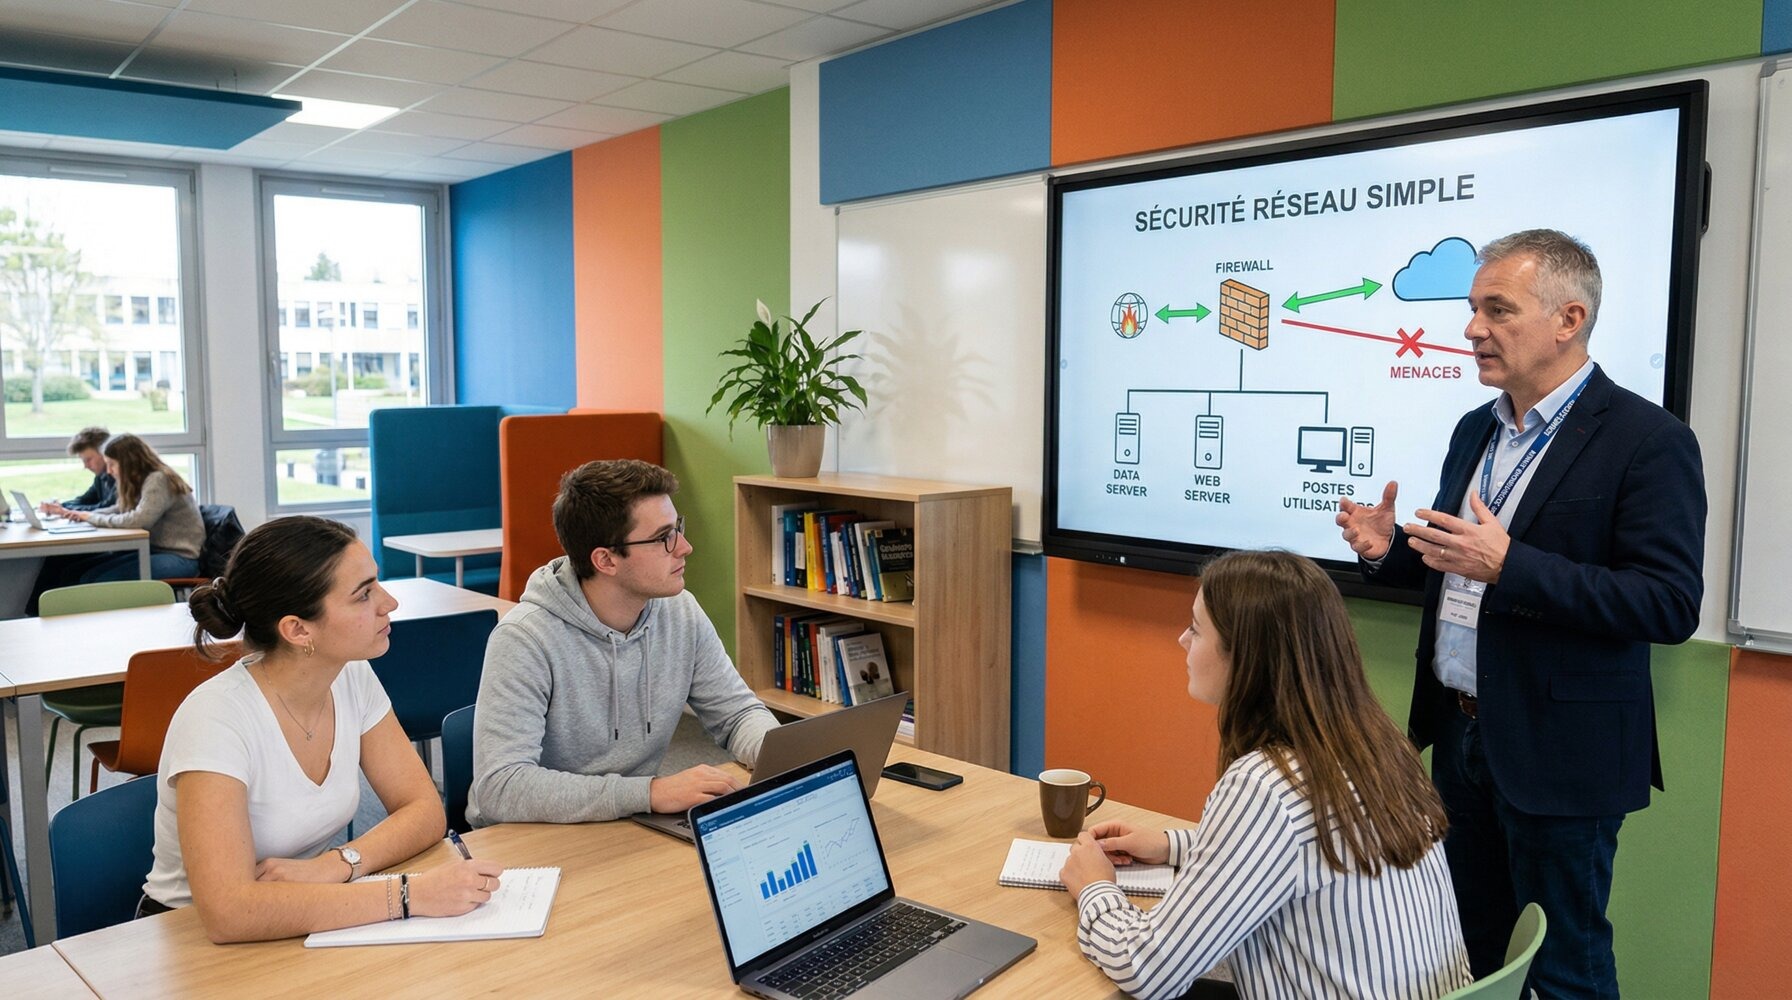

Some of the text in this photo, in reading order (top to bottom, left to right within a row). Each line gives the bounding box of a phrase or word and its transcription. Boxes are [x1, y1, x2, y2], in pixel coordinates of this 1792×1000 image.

[1135, 173, 1475, 233] SÉCURITÉ RÉSEAU SIMPLE
[1215, 259, 1274, 274] FIREWALL
[1390, 366, 1462, 379] MENACES
[1113, 468, 1140, 481] DATA
[1194, 474, 1221, 487] WEB
[1106, 483, 1147, 497] SERVER
[1302, 481, 1355, 496] POSTES
[1184, 489, 1231, 505] SERVER
[1283, 496, 1375, 513] UTILISAT
